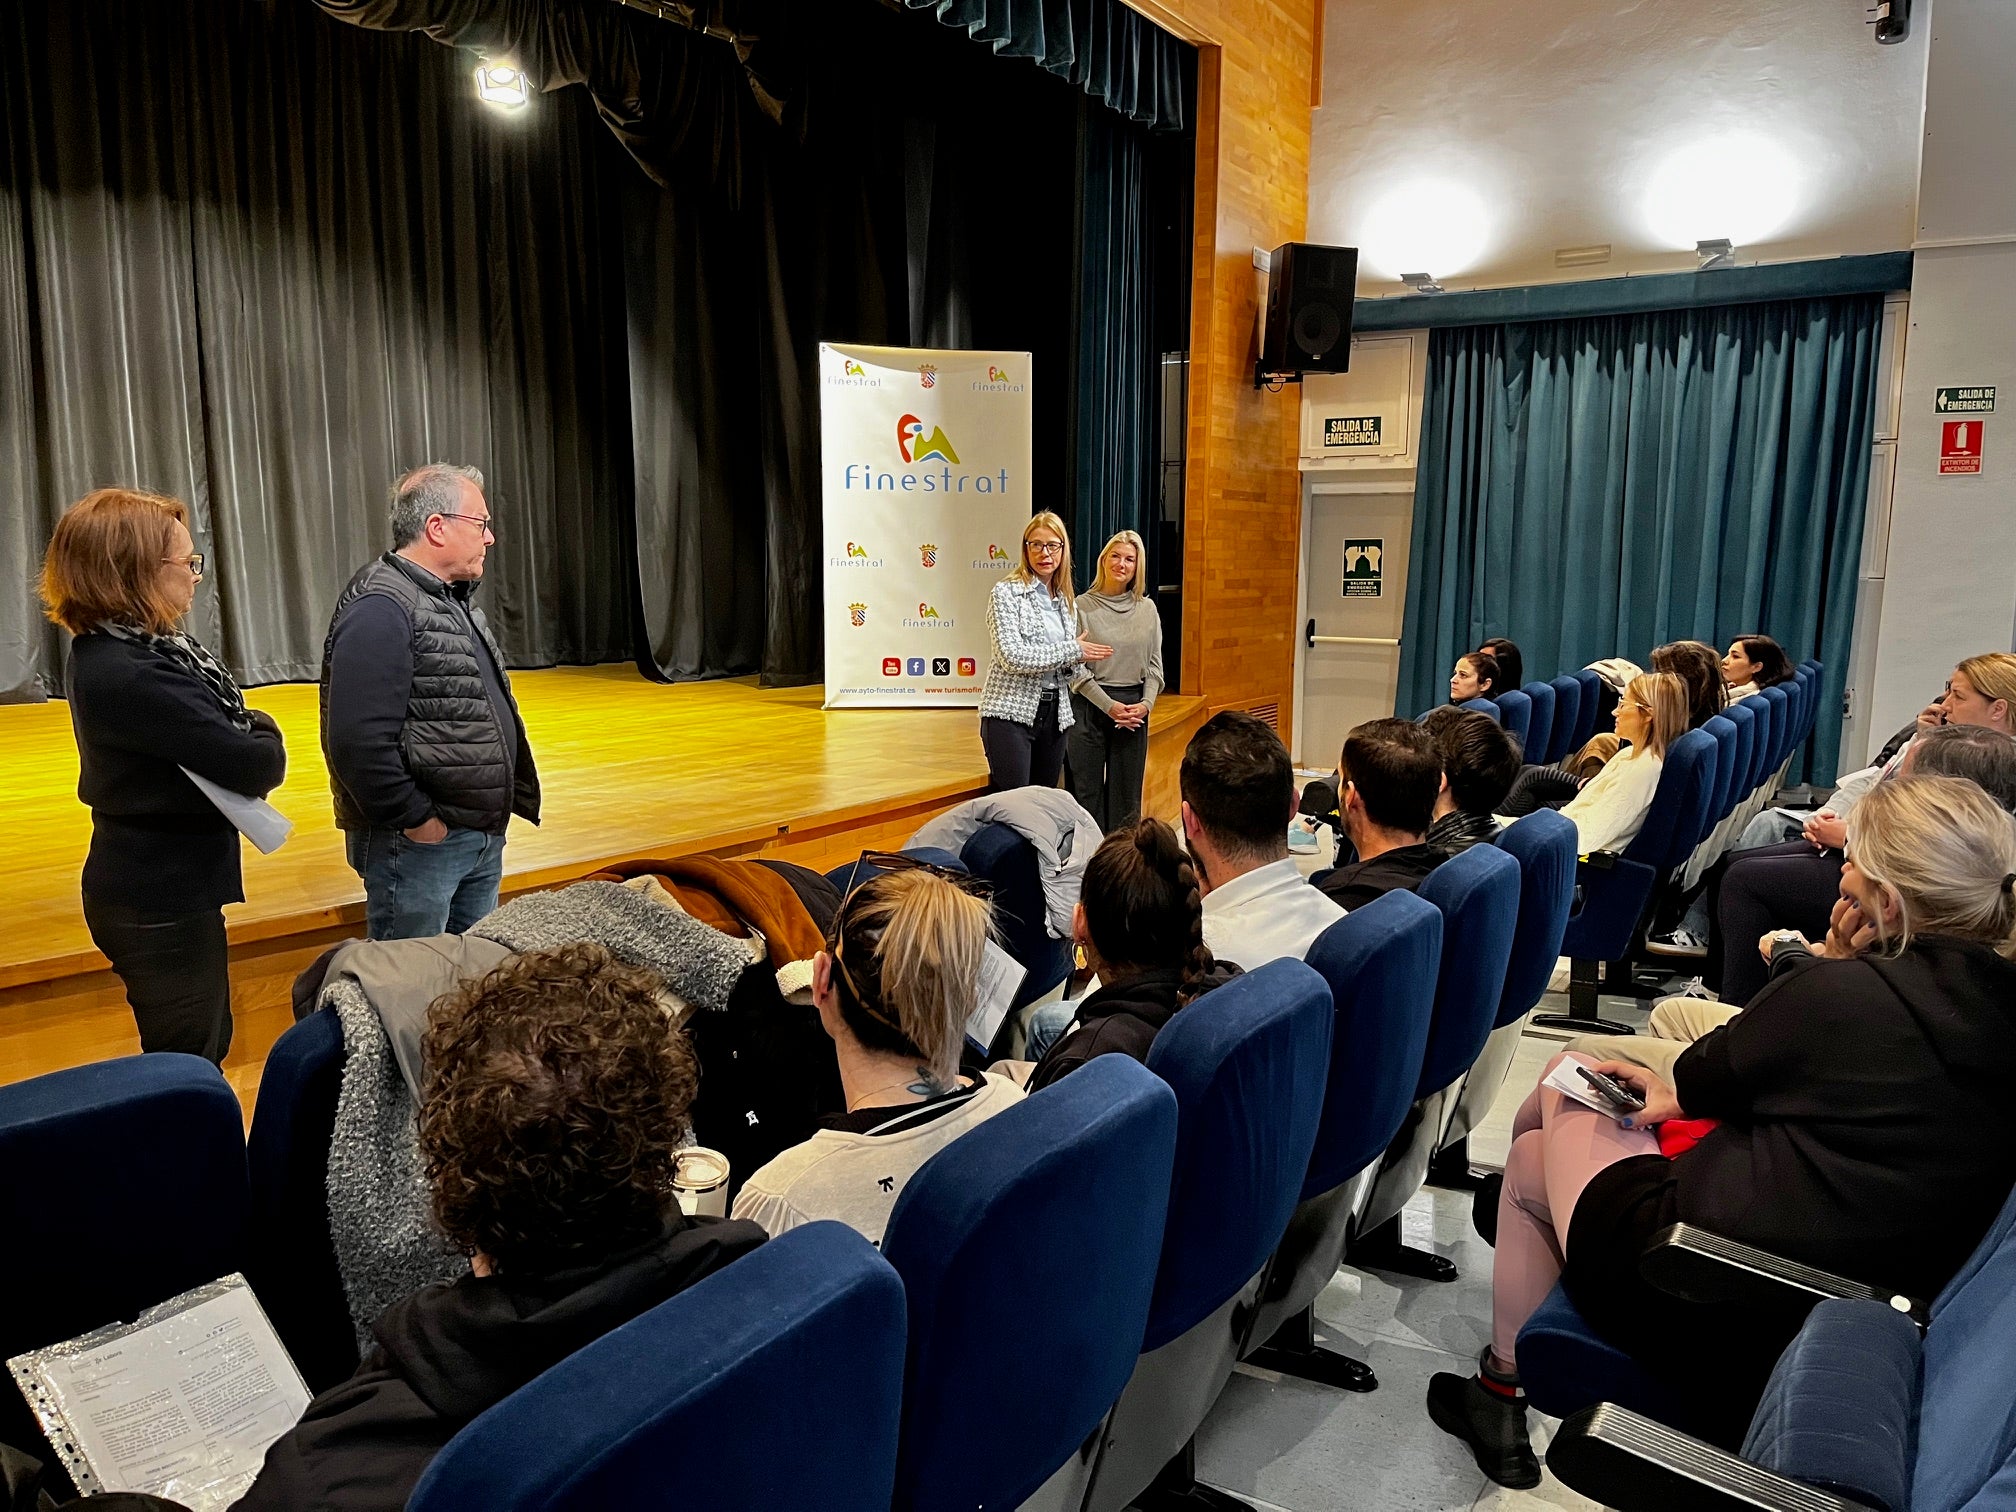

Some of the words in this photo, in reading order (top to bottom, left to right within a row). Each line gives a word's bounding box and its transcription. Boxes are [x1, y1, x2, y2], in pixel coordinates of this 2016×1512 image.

[1958, 389, 1983, 399] SALIDA
[1984, 388, 1994, 398] DE
[1947, 400, 1993, 410] EMERGENCIA
[1331, 420, 1360, 432] SALIDA
[1363, 419, 1374, 431] DE
[1326, 431, 1379, 445] EMERGENCIA
[924, 686, 982, 694] www.turismofin
